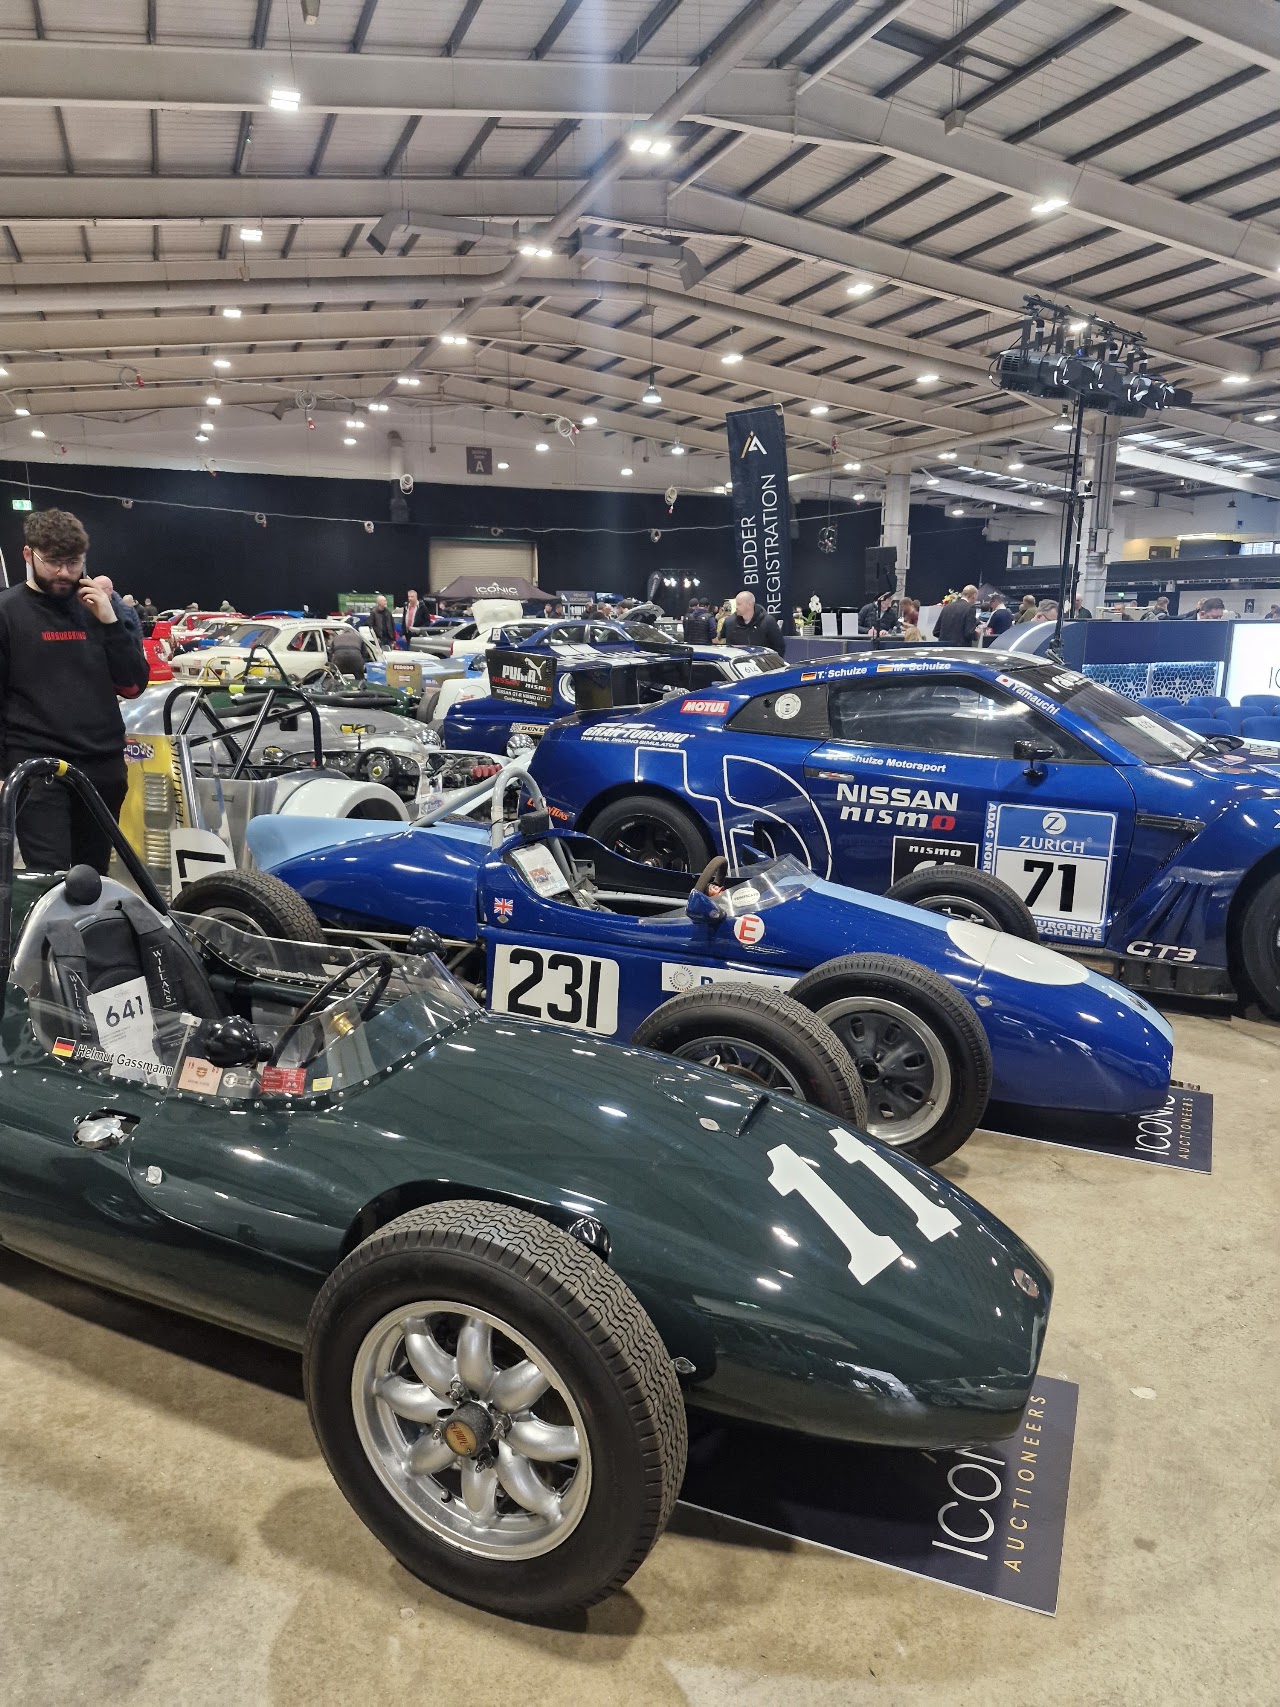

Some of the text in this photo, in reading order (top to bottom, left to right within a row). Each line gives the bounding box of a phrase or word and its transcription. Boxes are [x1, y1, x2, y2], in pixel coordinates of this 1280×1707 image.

[740, 515, 759, 585] BIDDER
[761, 474, 782, 614] REGISTRATION
[475, 586, 518, 594] ICONIC
[827, 667, 868, 679] Schulze
[908, 662, 952, 672] Schulze
[682, 701, 726, 714] MOTUL
[1010, 682, 1061, 716] Yamauchi
[583, 726, 690, 743] GRAN TURISMO
[886, 758, 947, 773] Motorsport
[171, 740, 184, 826] TEAM LOTUS
[836, 783, 959, 812] NISSAN
[839, 805, 956, 831] nismo
[985, 802, 997, 839] ADAC
[908, 844, 962, 857] nismo
[1018, 836, 1085, 854] ZURICH
[1023, 859, 1078, 913] 71
[738, 915, 760, 942] E
[1126, 941, 1197, 962] GT3
[152, 949, 172, 1003] WILLANS
[508, 947, 602, 1028] 231
[105, 995, 145, 1028] 641
[76, 1043, 175, 1077] Helmut Gassmann
[1178, 1097, 1194, 1160] AUCTIONEERS
[767, 1126, 962, 1286] 11
[1003, 1394, 1046, 1573] AUCTIONEERS
